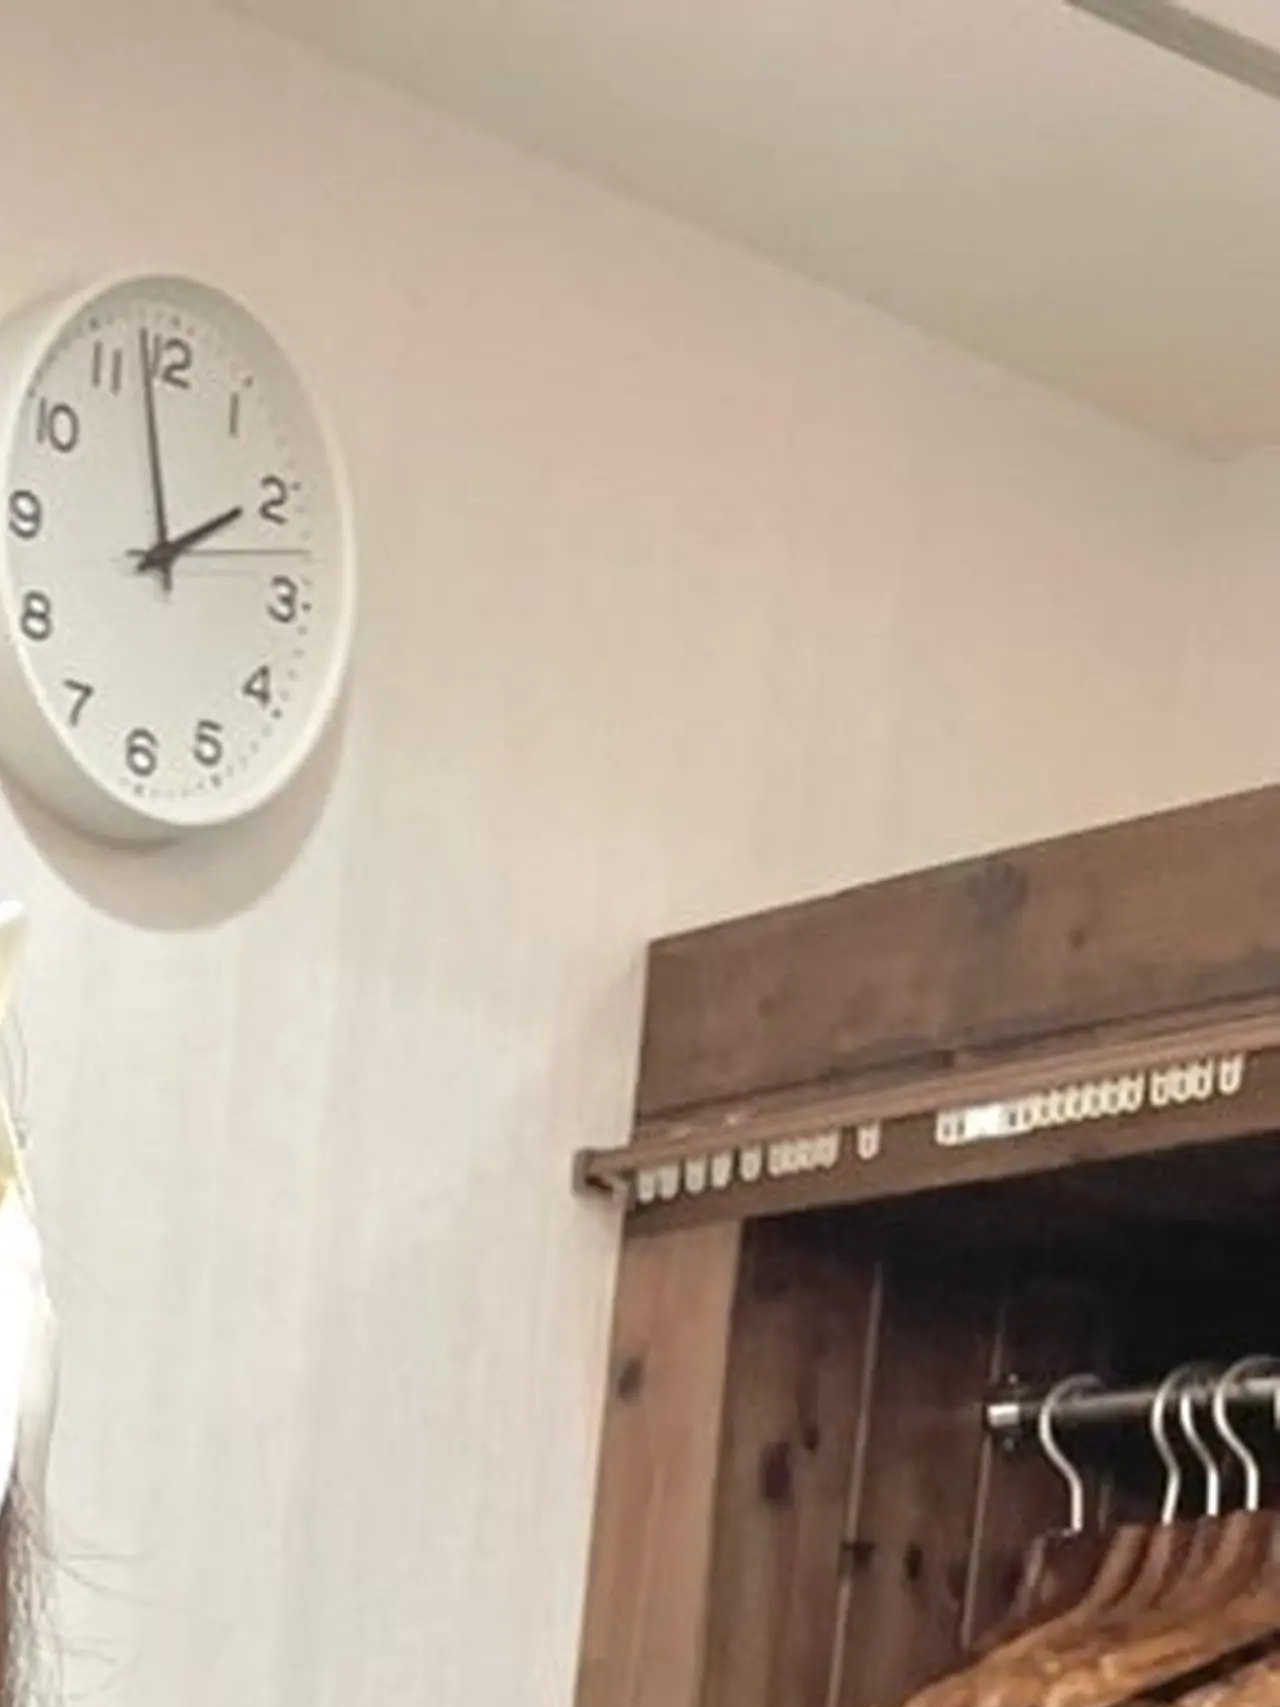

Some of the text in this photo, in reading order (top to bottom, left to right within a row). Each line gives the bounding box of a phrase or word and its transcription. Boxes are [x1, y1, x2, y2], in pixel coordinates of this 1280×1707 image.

[92, 339, 122, 397] 11
[151, 331, 193, 390] 12
[36, 397, 80, 454] 10
[7, 488, 41, 539] 9
[257, 474, 290, 525] 2
[19, 589, 53, 642] 8
[267, 575, 299, 624] 3
[62, 678, 96, 728] 7
[241, 664, 273, 708] 4
[124, 727, 158, 777] 6
[192, 718, 224, 768] 5
